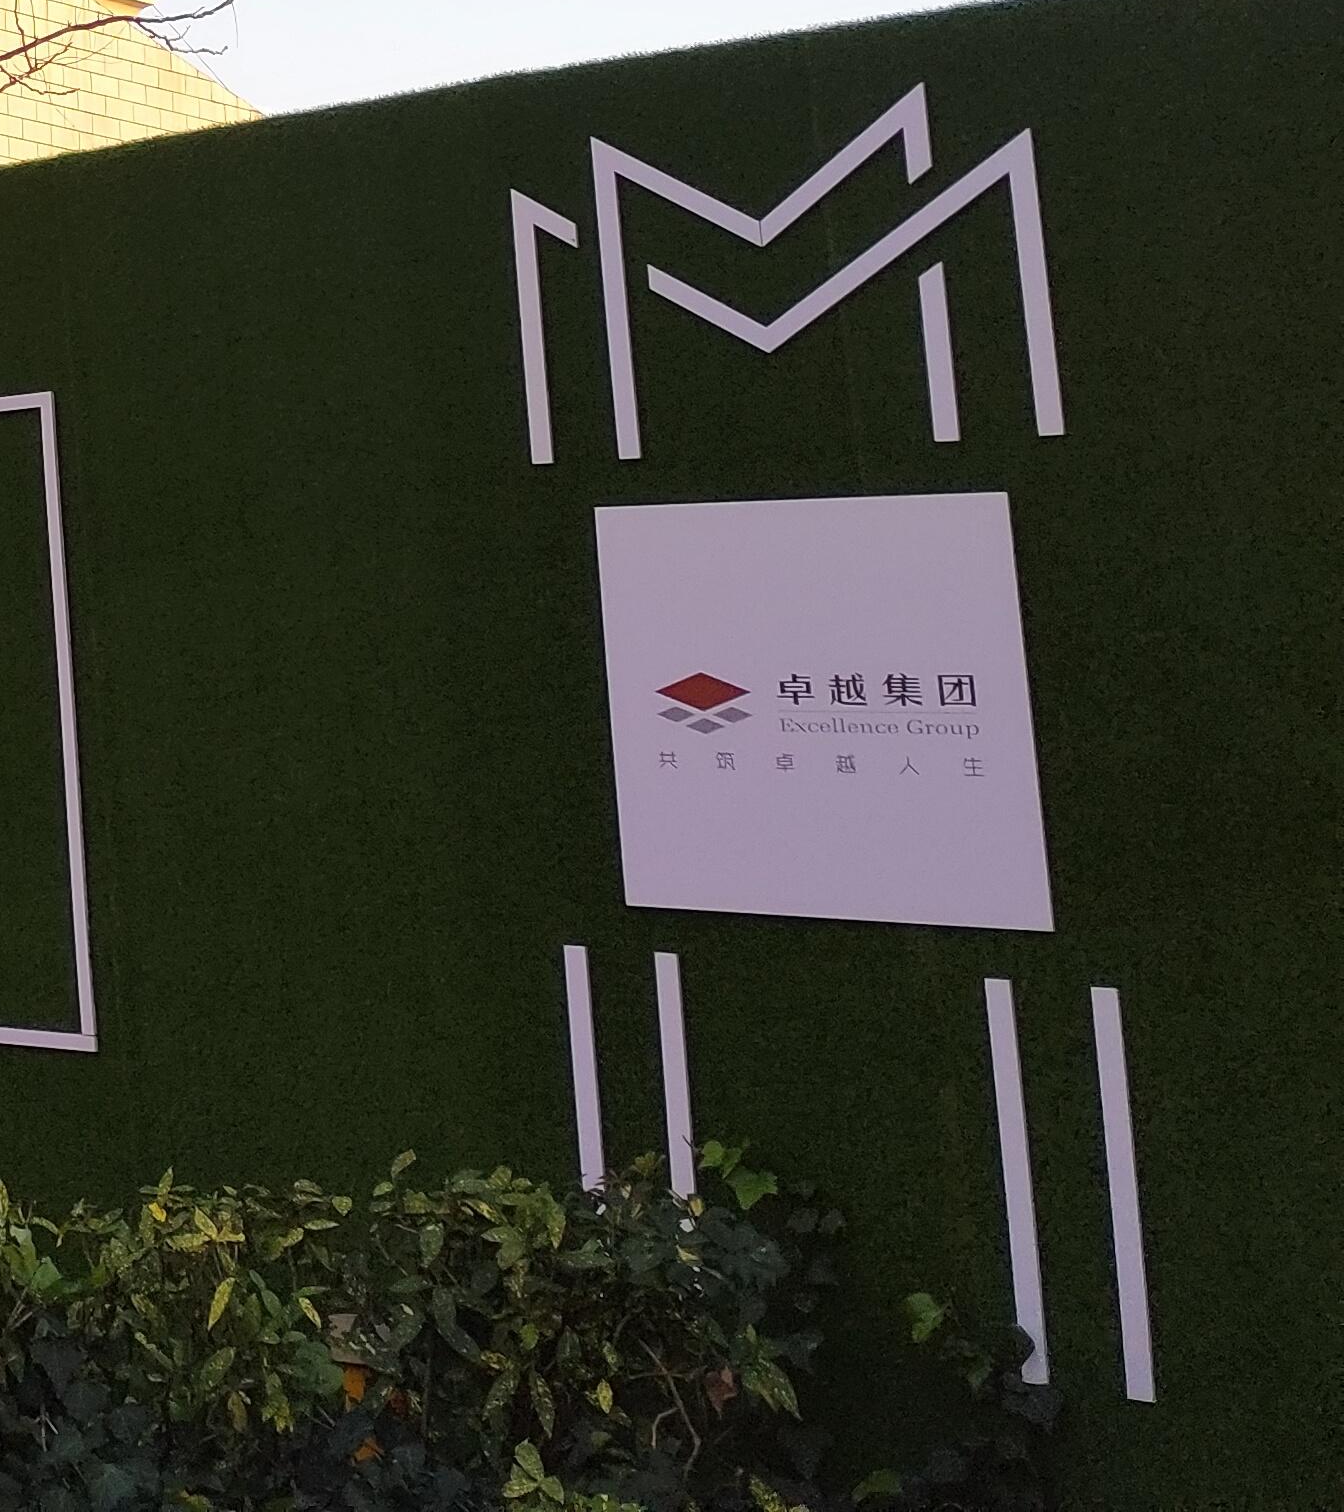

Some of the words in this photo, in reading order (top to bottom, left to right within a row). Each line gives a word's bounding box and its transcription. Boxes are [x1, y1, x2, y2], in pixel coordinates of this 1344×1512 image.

[776, 672, 978, 707] 卓越集团
[779, 717, 899, 736] Excellence
[906, 720, 980, 740] Group
[658, 751, 985, 777] 共筑卓越人生
